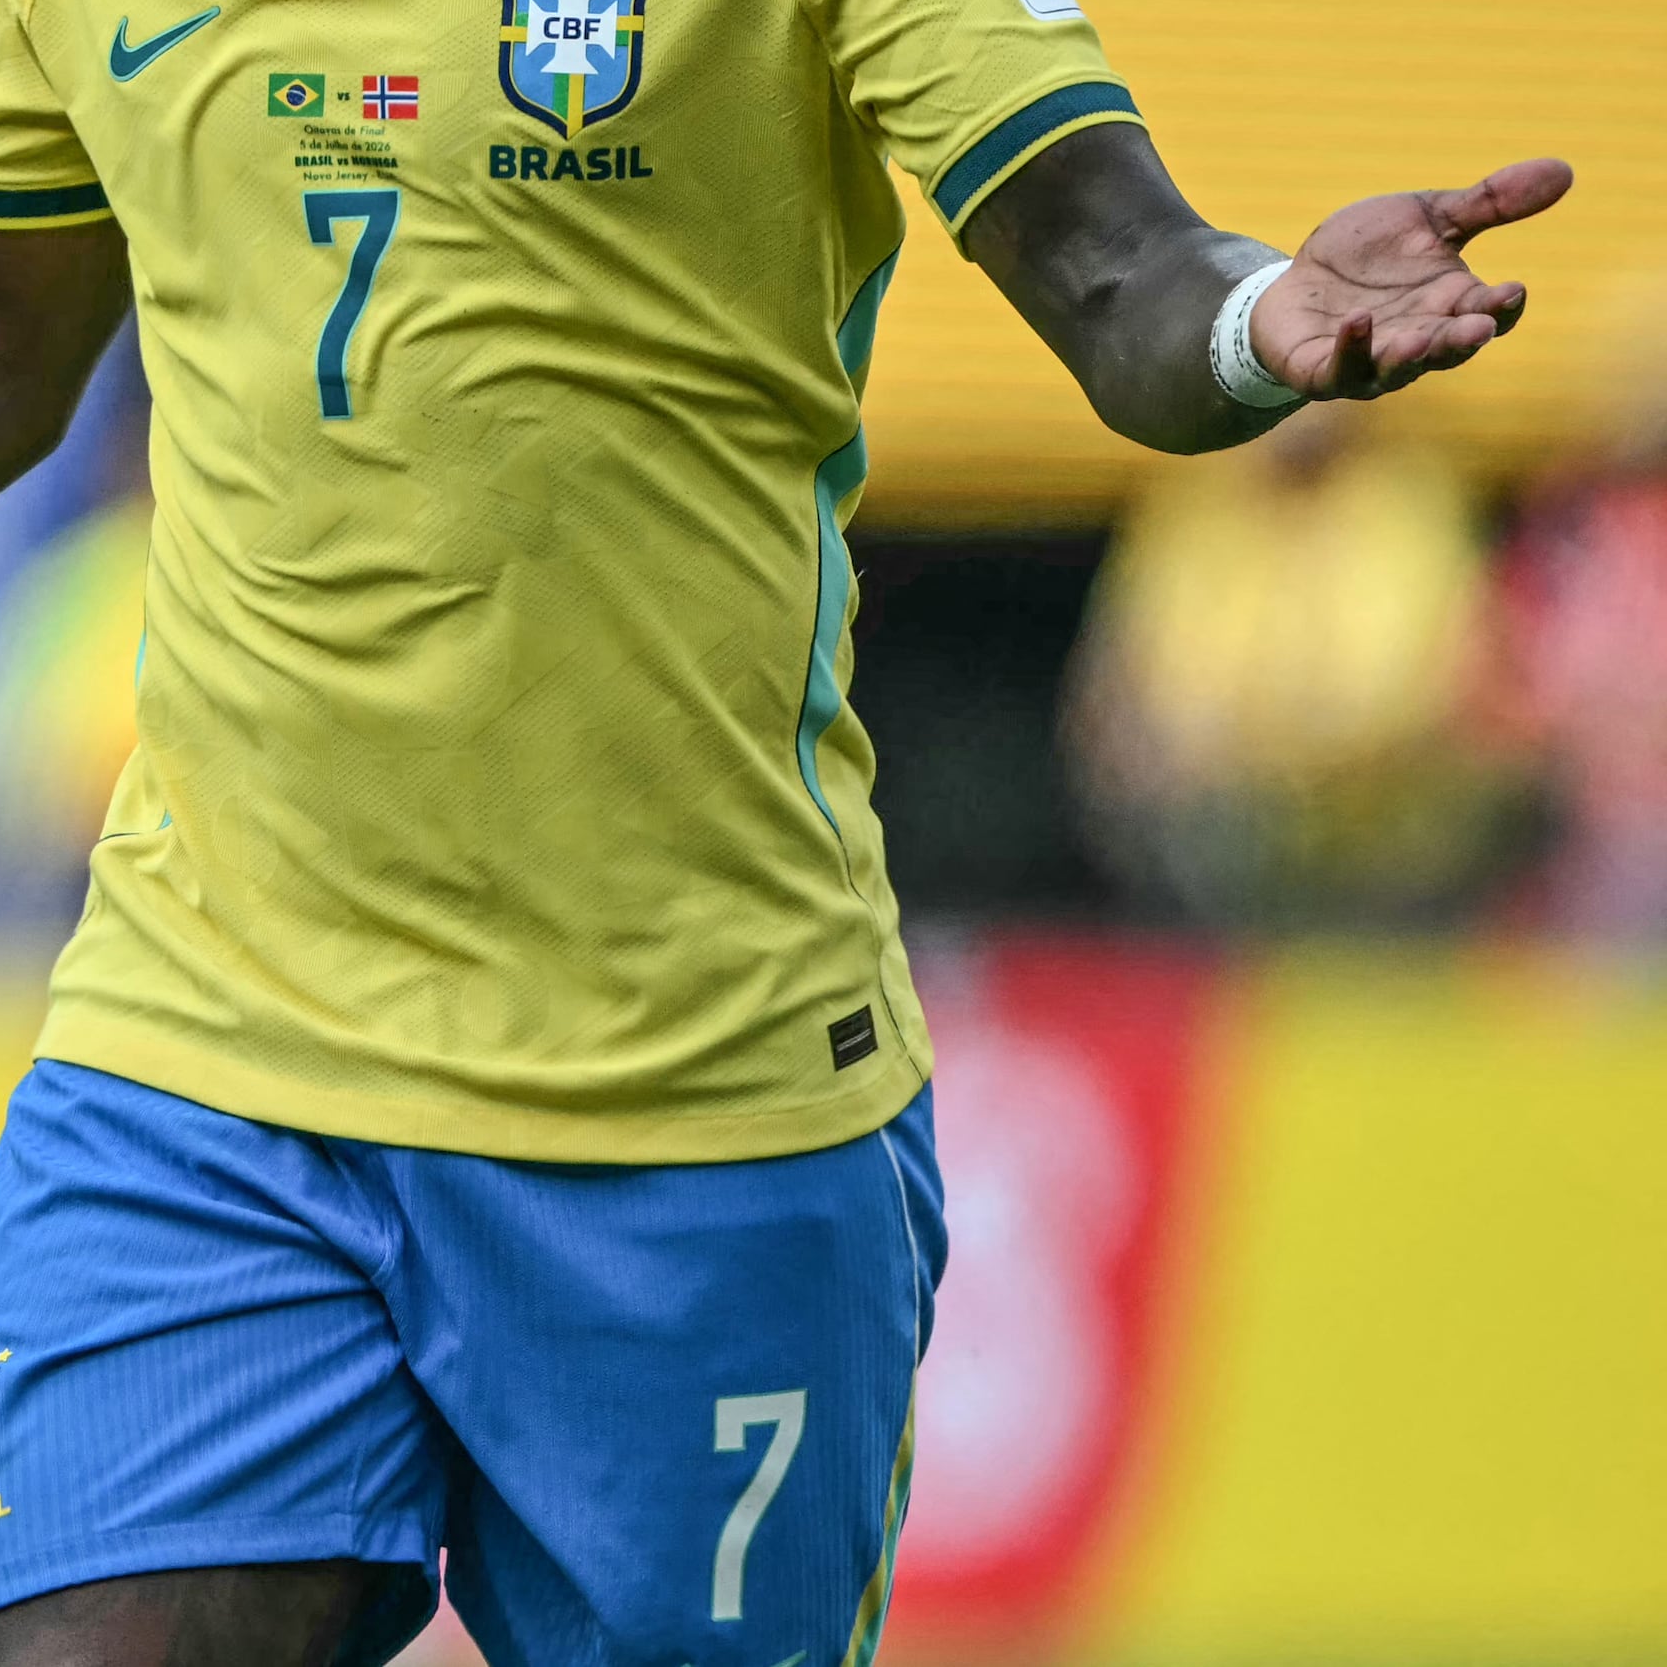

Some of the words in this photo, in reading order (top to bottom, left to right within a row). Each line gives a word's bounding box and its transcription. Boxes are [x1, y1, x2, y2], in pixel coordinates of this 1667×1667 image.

[543, 16, 601, 40] CBF
[360, 125, 386, 135] Final
[364, 141, 391, 152] 2026
[295, 155, 333, 167] BRASIL
[489, 145, 653, 181] BRASIL
[302, 189, 401, 420] 7
[711, 1389, 808, 1621] 7
